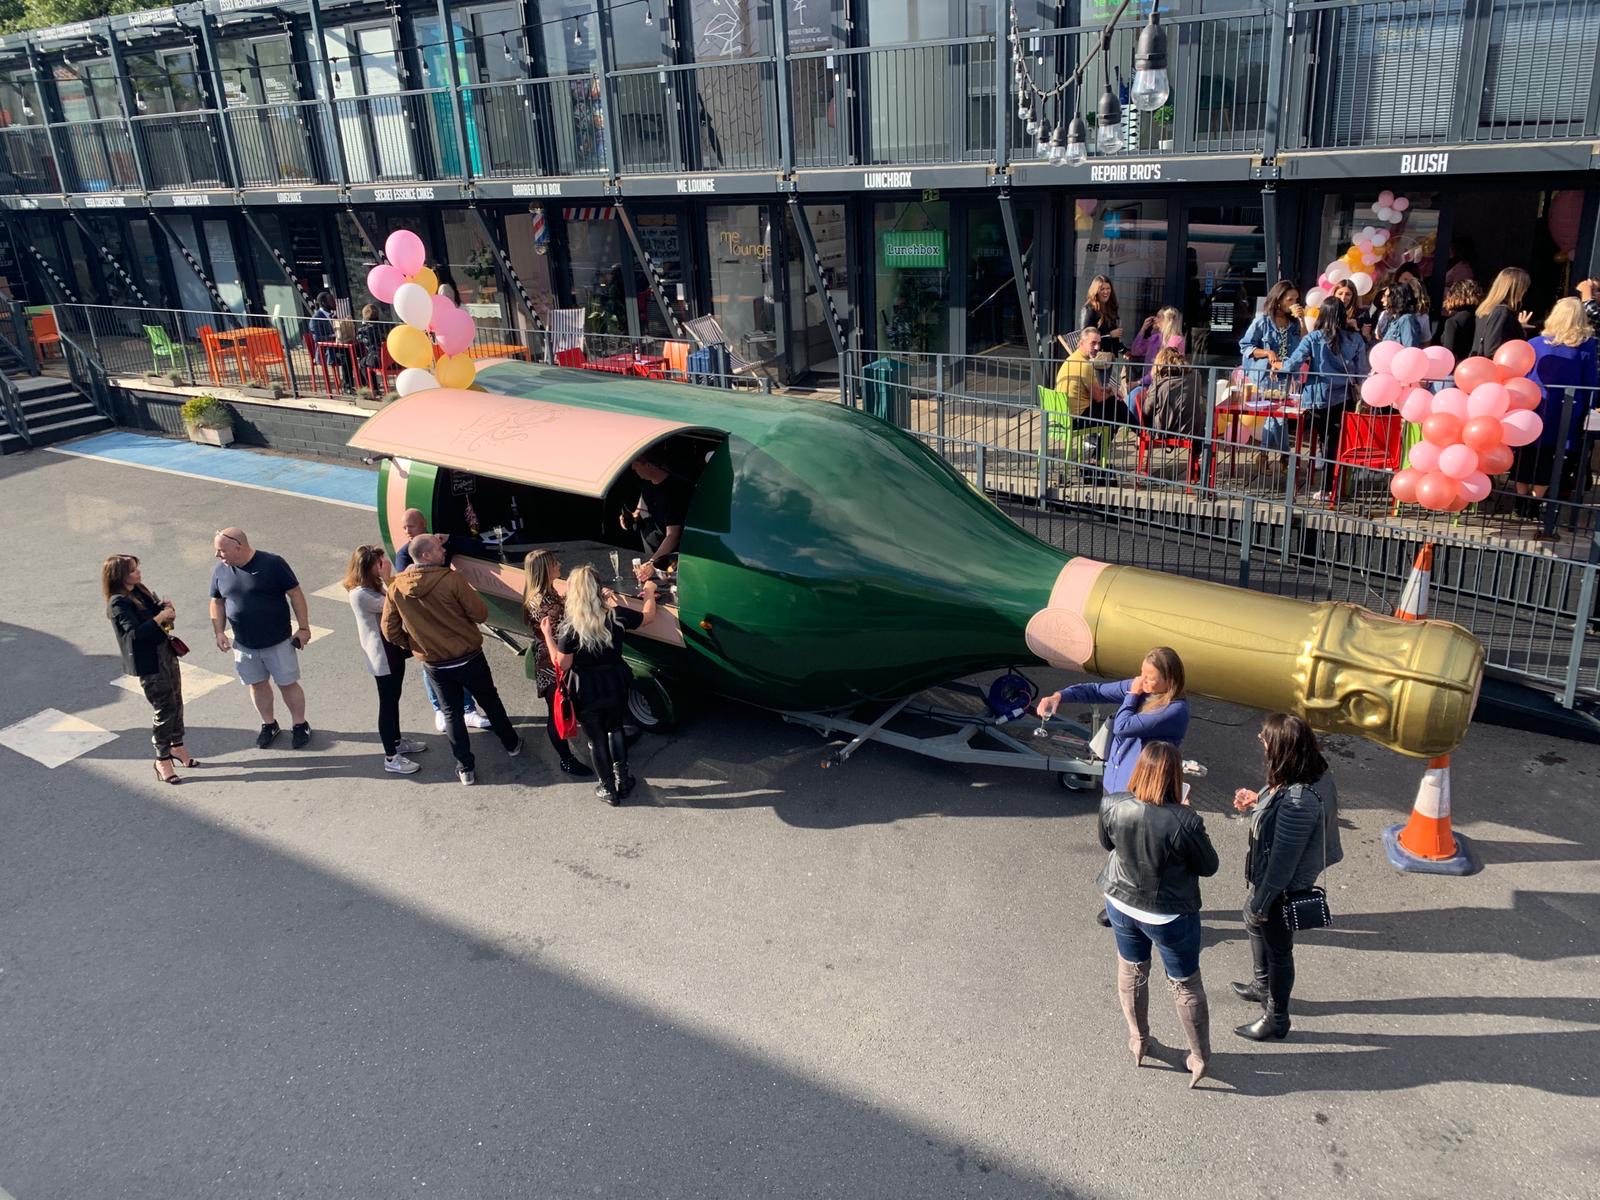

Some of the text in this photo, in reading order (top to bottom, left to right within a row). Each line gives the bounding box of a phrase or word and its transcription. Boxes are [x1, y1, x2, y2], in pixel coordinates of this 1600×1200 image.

[1400, 153, 1449, 173] BLUSH
[1091, 164, 1161, 181] REPAIR PRO'S
[676, 178, 715, 192] ME LOUNGE
[864, 172, 912, 188] LUNCHBOX
[374, 187, 434, 201] SECRET ESSENCE CAKES
[512, 184, 535, 196] BARBER
[535, 183, 543, 195] IN
[548, 183, 561, 195] BOX
[720, 231, 740, 242] me
[729, 241, 772, 260] lounge
[887, 244, 940, 256] Lunchbox
